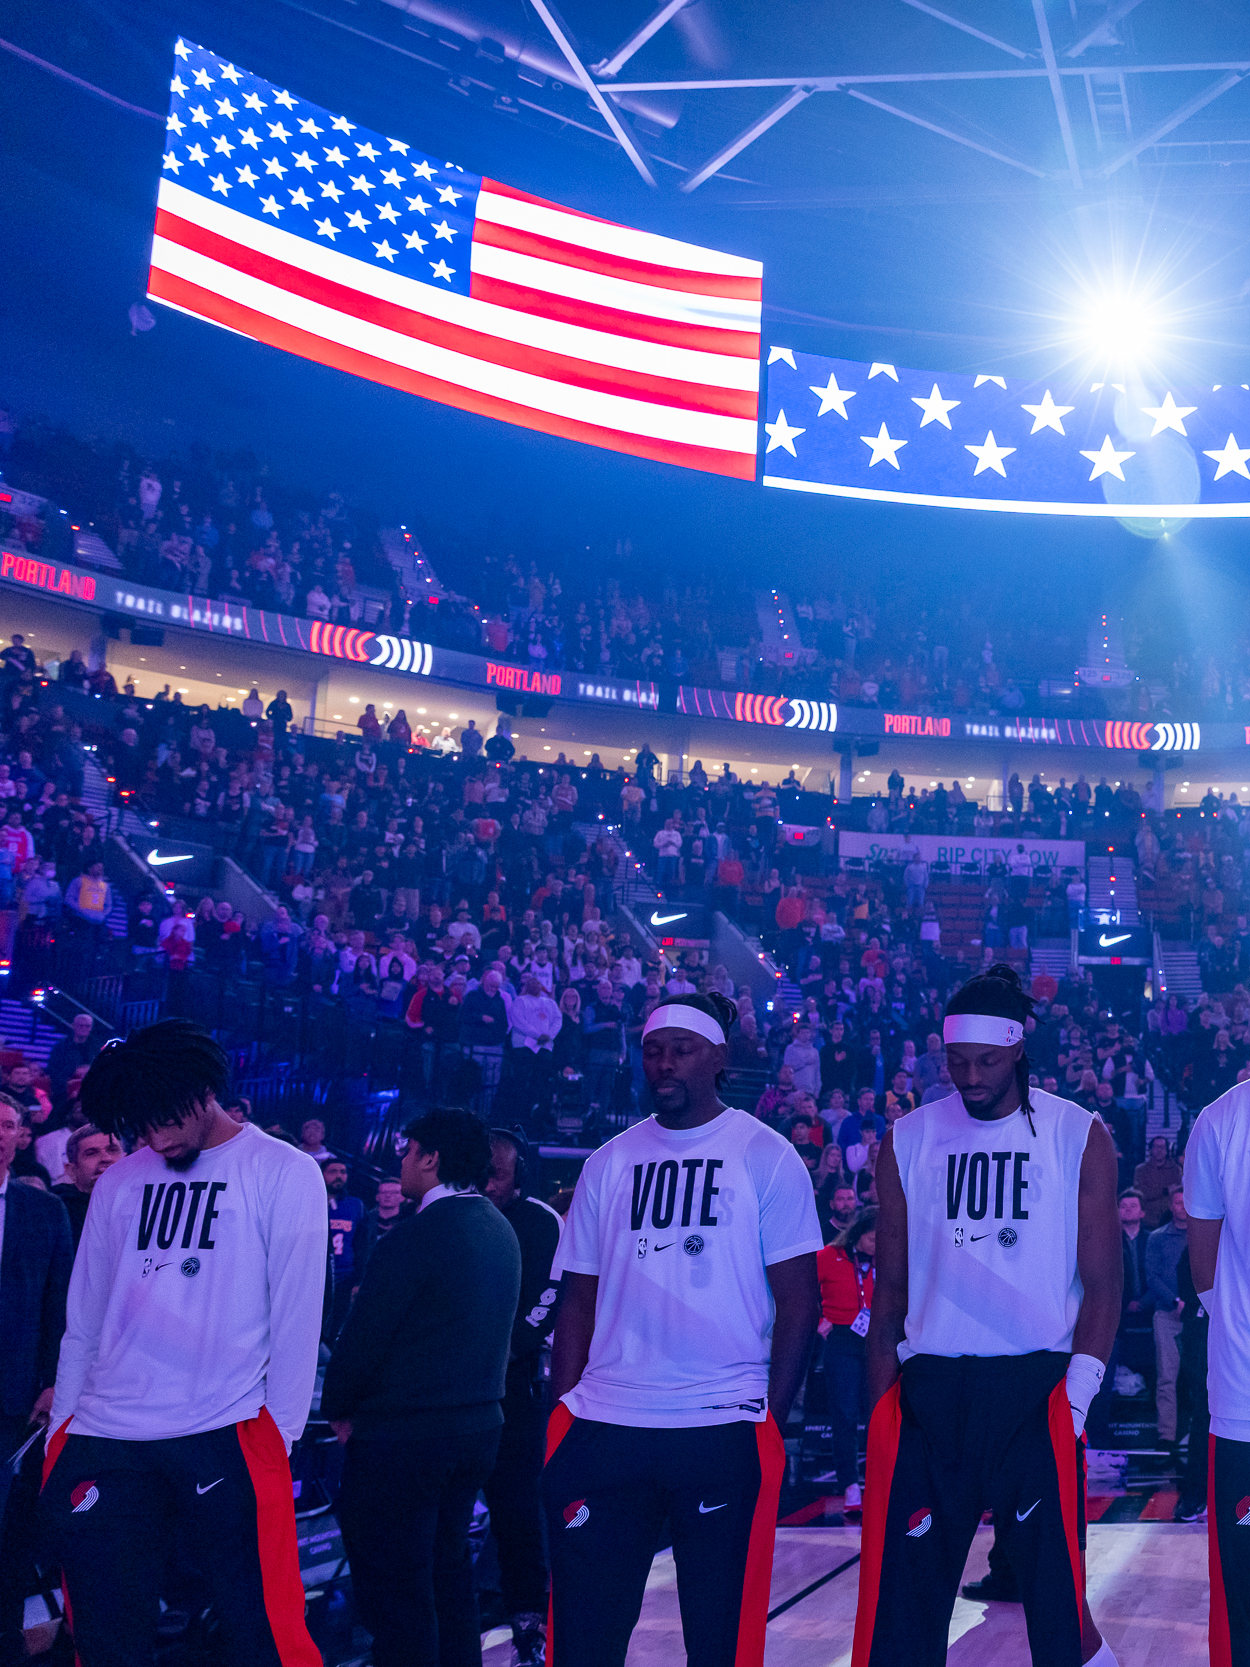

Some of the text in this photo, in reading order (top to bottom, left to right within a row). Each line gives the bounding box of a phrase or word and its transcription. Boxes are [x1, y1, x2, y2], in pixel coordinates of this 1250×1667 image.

[1, 552, 96, 600] PORTLAND
[486, 662, 561, 695] PORTLAND
[884, 714, 950, 737] PORTLAND
[937, 847, 965, 863] RIP
[971, 848, 1012, 865] CITY
[631, 1159, 724, 1231] VOTE
[947, 1152, 1030, 1220] VOTE
[137, 1181, 228, 1251] VOTE
